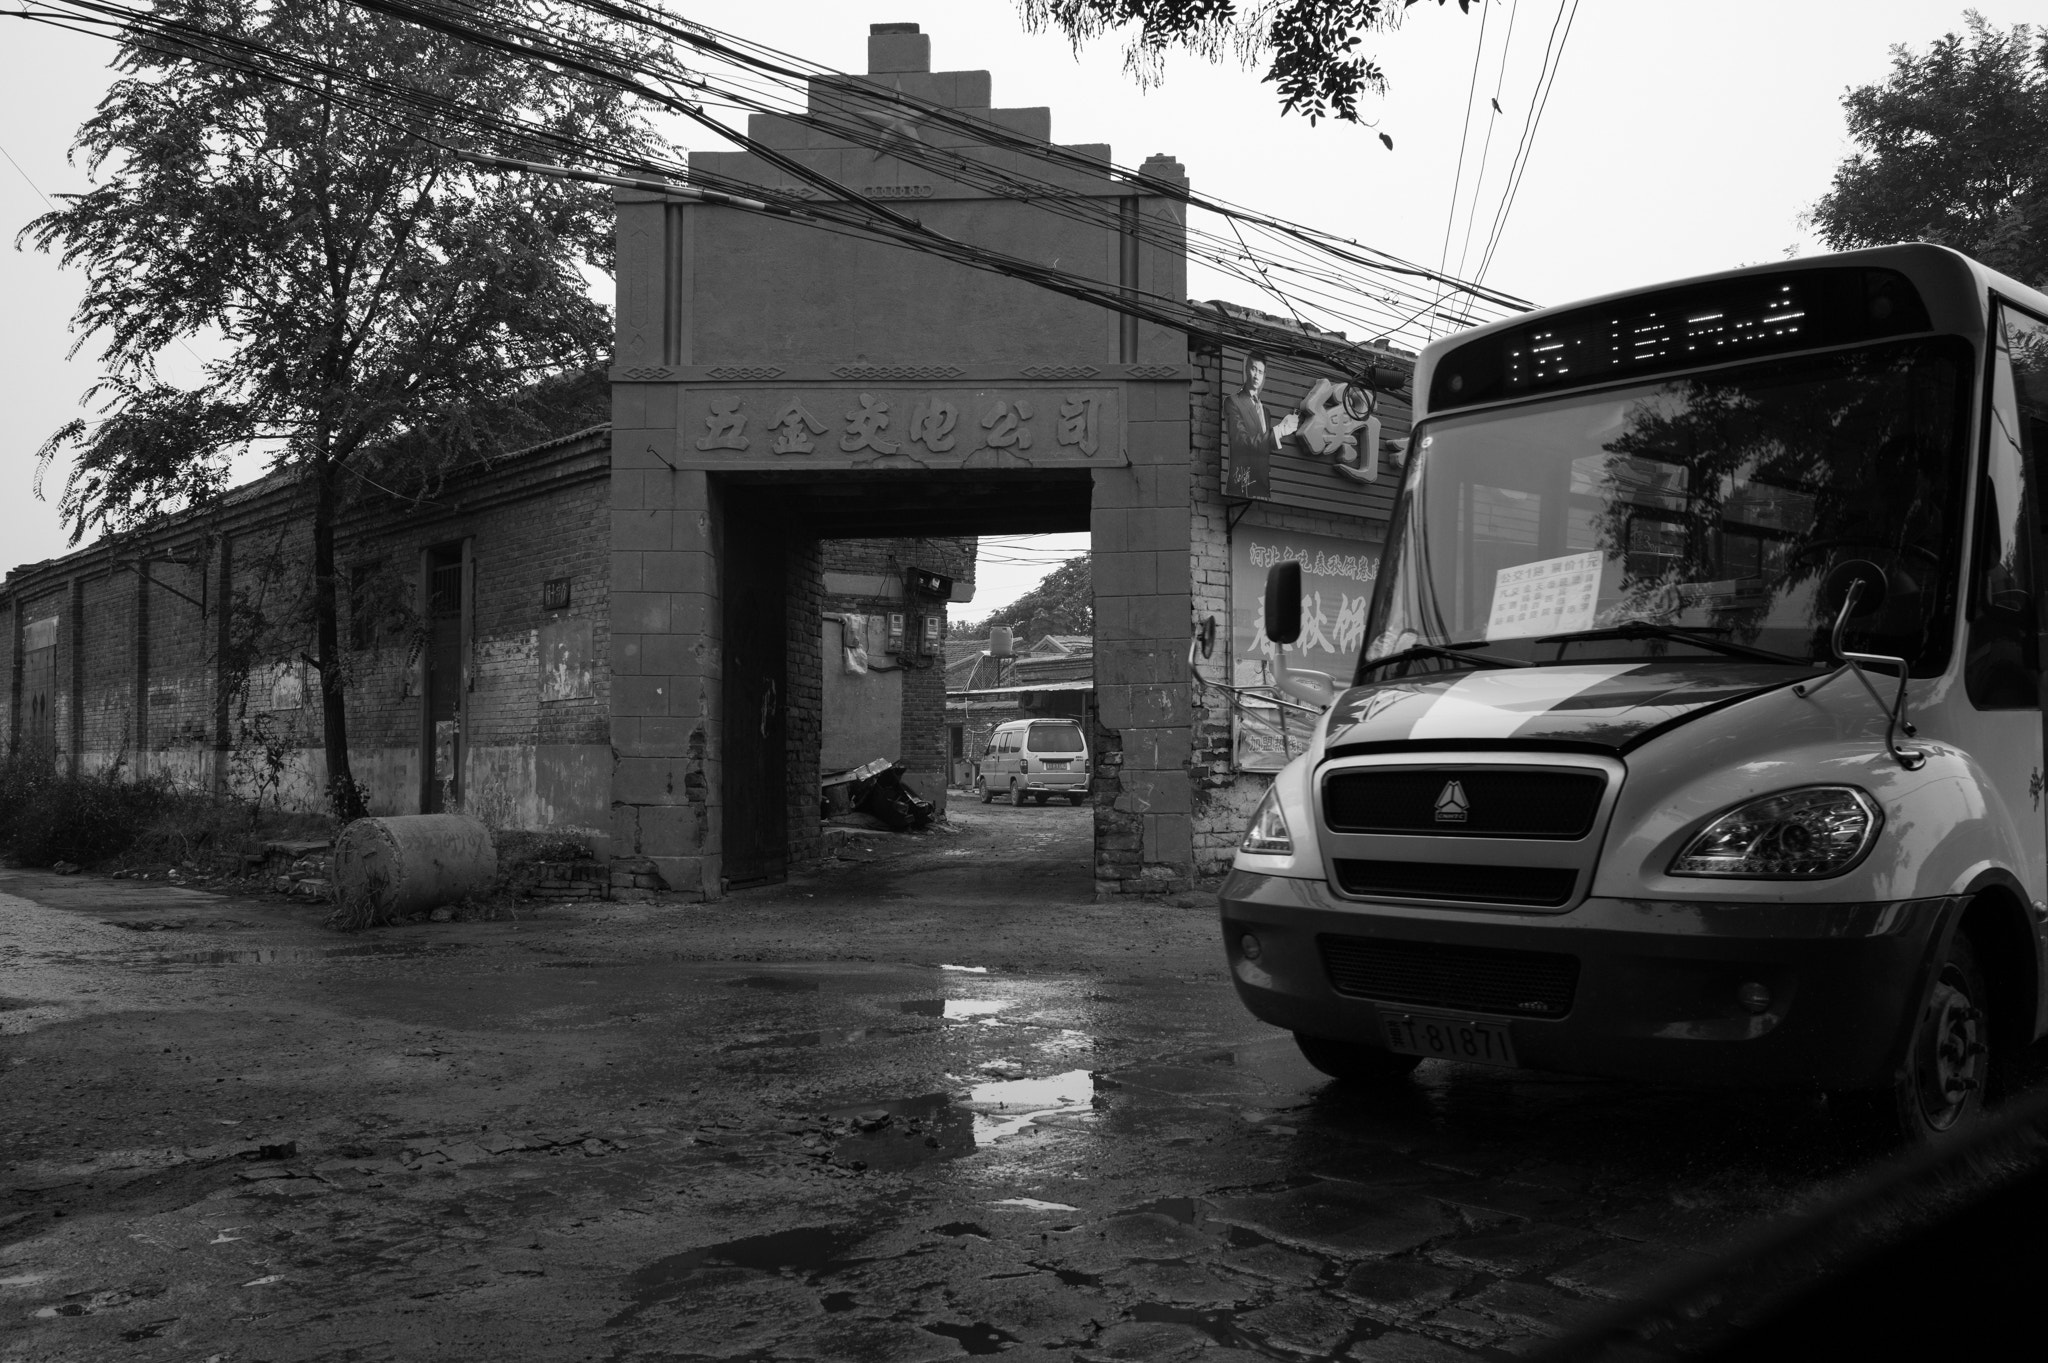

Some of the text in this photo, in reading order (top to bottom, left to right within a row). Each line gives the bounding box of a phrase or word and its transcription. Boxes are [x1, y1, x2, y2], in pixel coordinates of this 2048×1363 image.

[696, 393, 1100, 457] 五金交电公司
